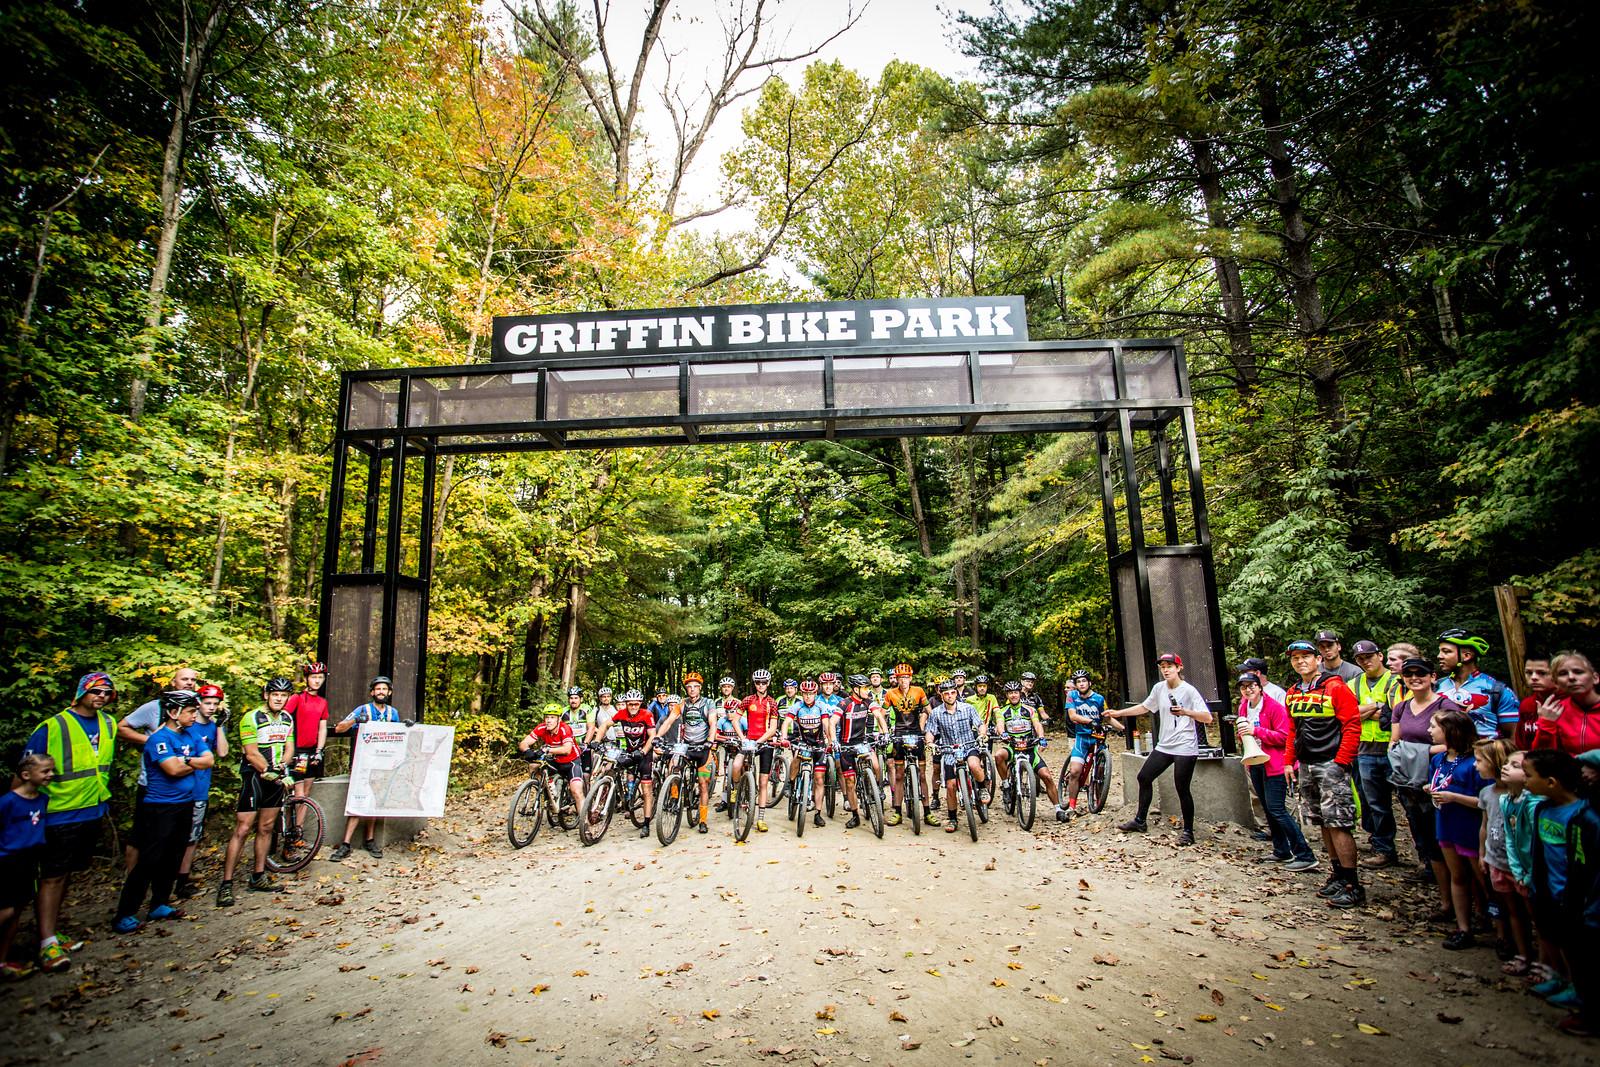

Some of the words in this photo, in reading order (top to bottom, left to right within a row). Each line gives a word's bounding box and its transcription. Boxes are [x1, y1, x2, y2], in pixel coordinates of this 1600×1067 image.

[504, 315, 715, 356] GRIFFIN
[728, 309, 857, 345] BIKE
[869, 306, 1014, 340] PARK
